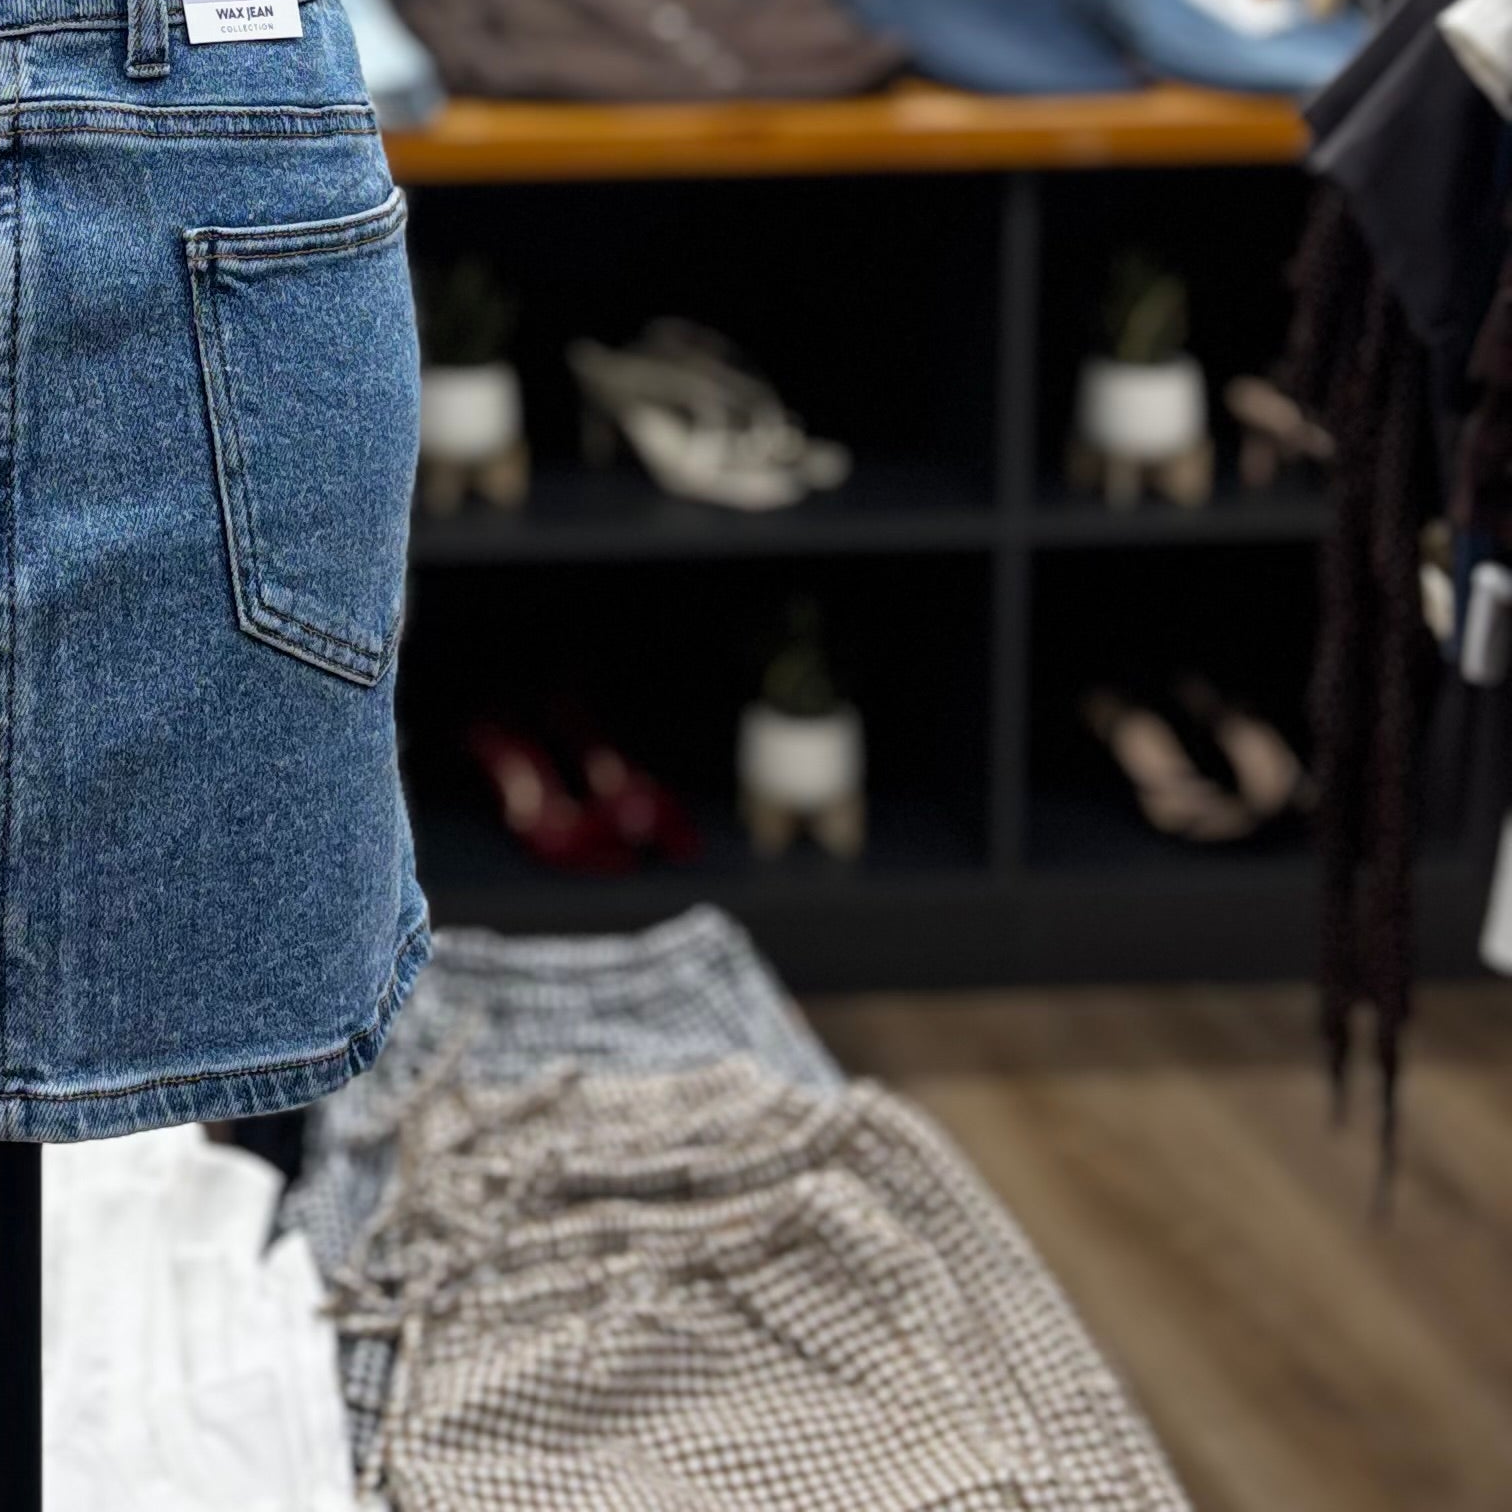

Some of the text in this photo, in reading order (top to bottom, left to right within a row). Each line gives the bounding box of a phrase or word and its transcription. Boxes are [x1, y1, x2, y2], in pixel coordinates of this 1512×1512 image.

[216, 5, 274, 21] WAX JEAN
[220, 23, 274, 34] COLLECTION
